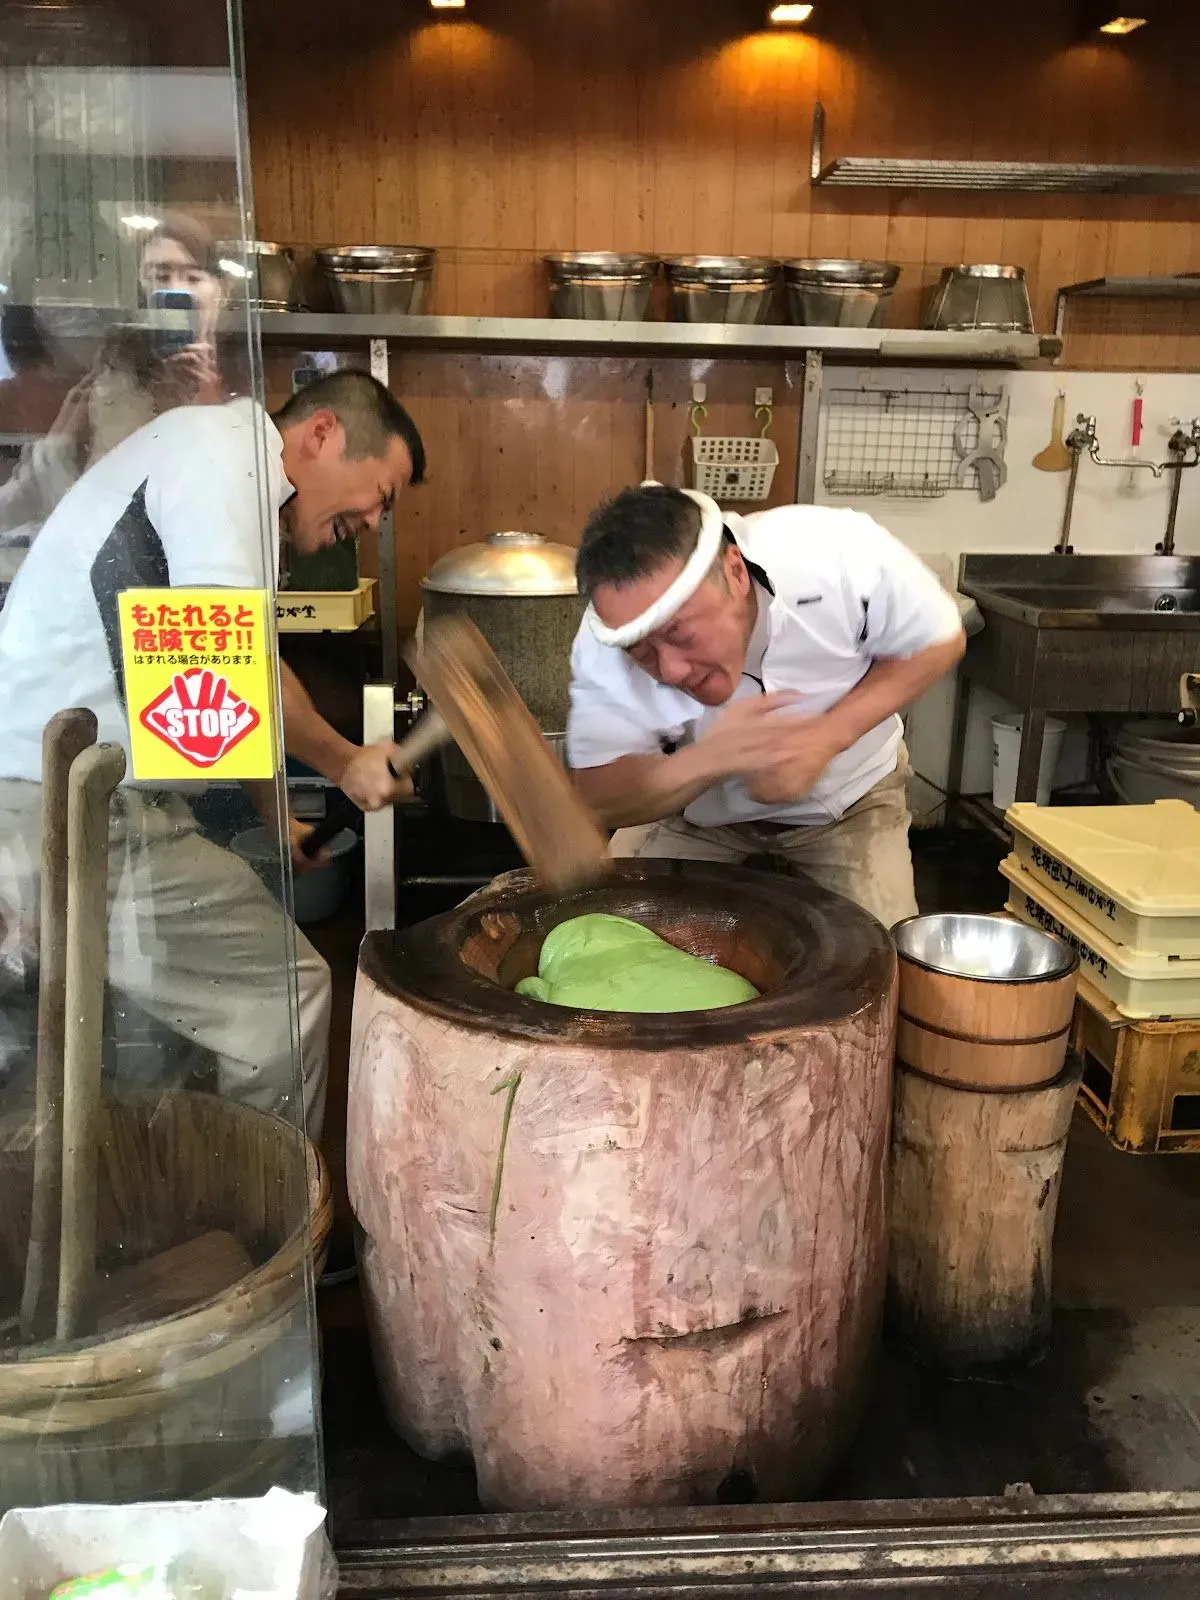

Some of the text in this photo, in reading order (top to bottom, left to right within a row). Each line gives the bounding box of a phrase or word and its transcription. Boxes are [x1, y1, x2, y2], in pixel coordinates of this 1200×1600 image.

[131, 604, 255, 628] もたれると
[132, 629, 253, 653] 危険です!!
[134, 655, 257, 665] はずれる場合があります。
[165, 708, 238, 738] STOP
